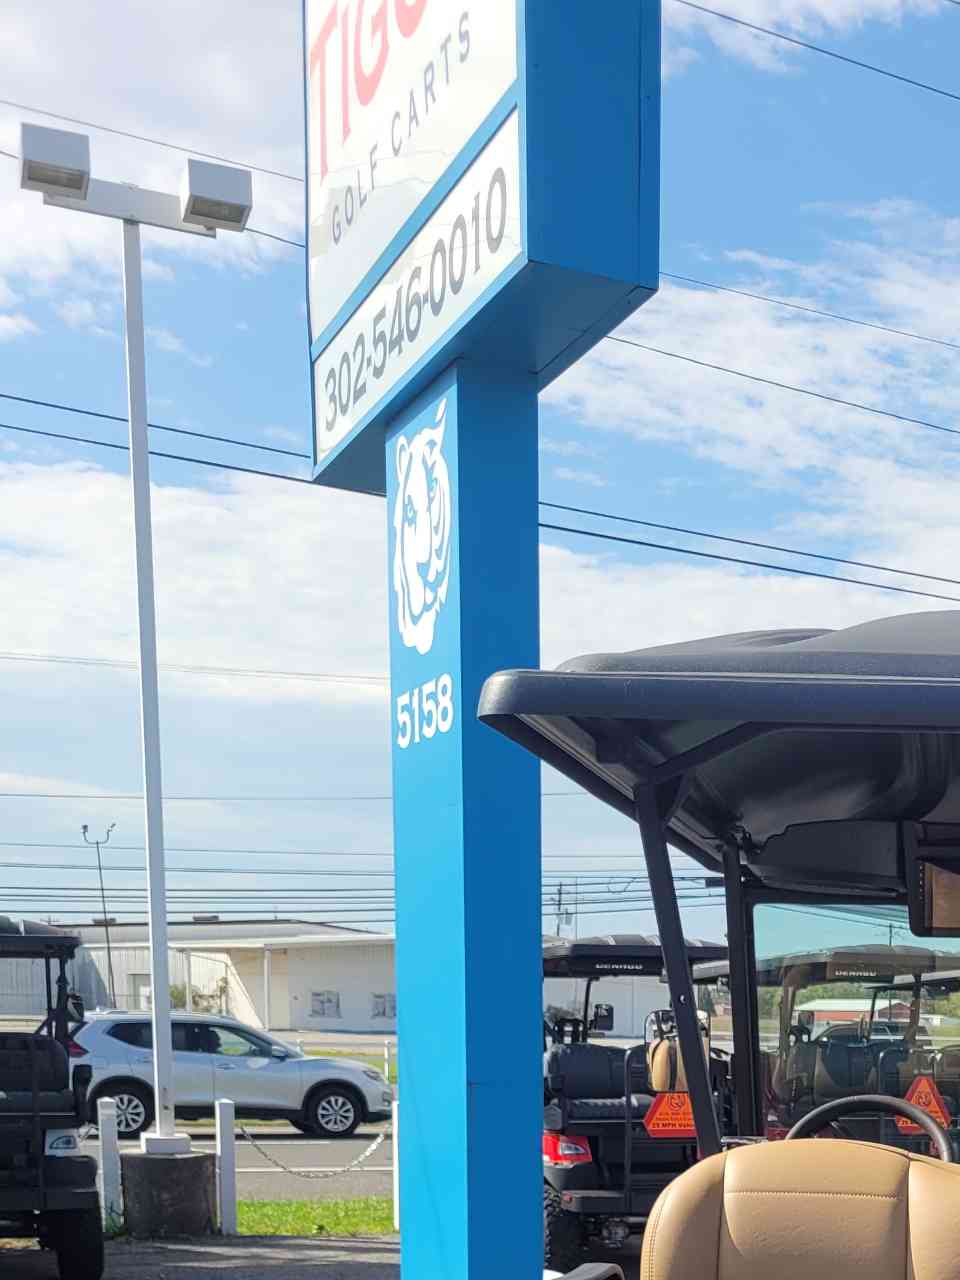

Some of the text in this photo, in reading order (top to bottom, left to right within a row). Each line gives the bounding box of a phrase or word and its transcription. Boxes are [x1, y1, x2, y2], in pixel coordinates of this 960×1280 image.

[310, 0, 428, 187] TIG
[332, 11, 470, 245] GOLF CARTS
[324, 167, 507, 432] 302-546-0010
[397, 673, 454, 749] 5158
